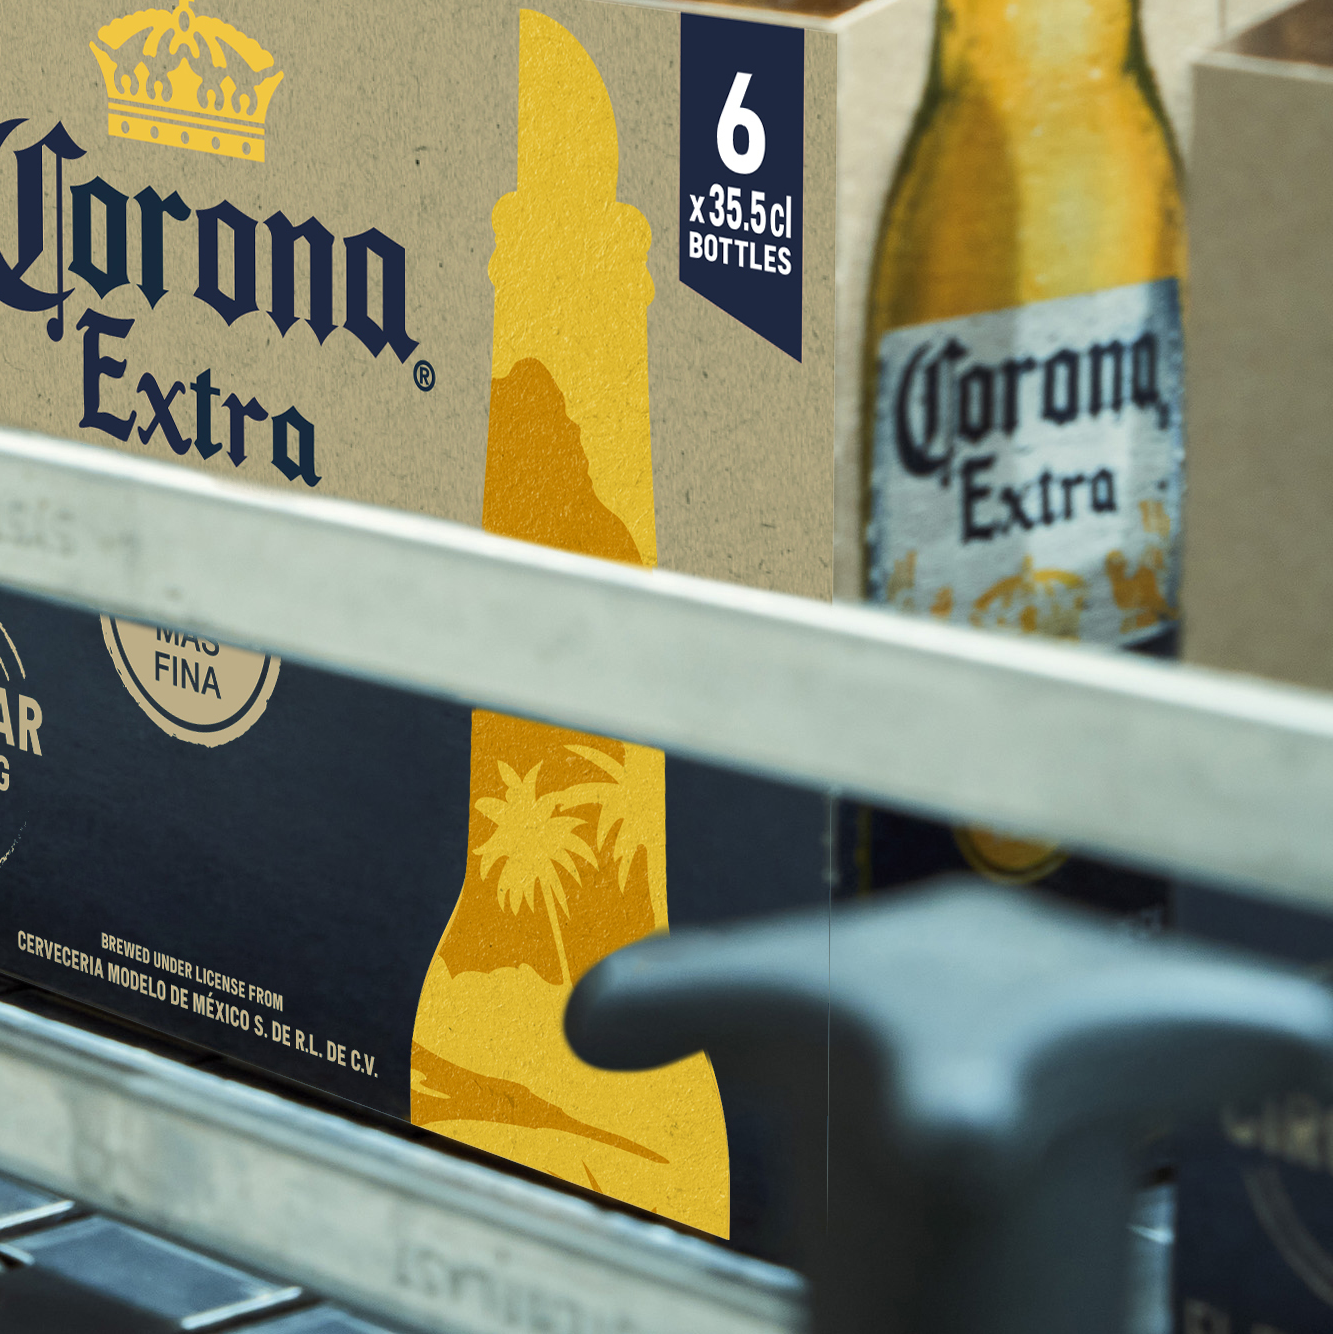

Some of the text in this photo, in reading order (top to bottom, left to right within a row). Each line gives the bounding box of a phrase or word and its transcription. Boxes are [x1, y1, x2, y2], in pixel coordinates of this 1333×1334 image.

[716, 71, 767, 176] 6
[689, 230, 793, 277] BOTTLES
[77, 307, 323, 488] Extra
[894, 330, 1165, 491] Corona
[959, 457, 1120, 545] Extra
[154, 650, 223, 701] FINA
[17, 929, 380, 1079] CERVECERIA MODELO DE MÉXICO S. DE R.L. DE C.V.
[100, 931, 284, 1013] BREWED UNDER LICENSE FROM
